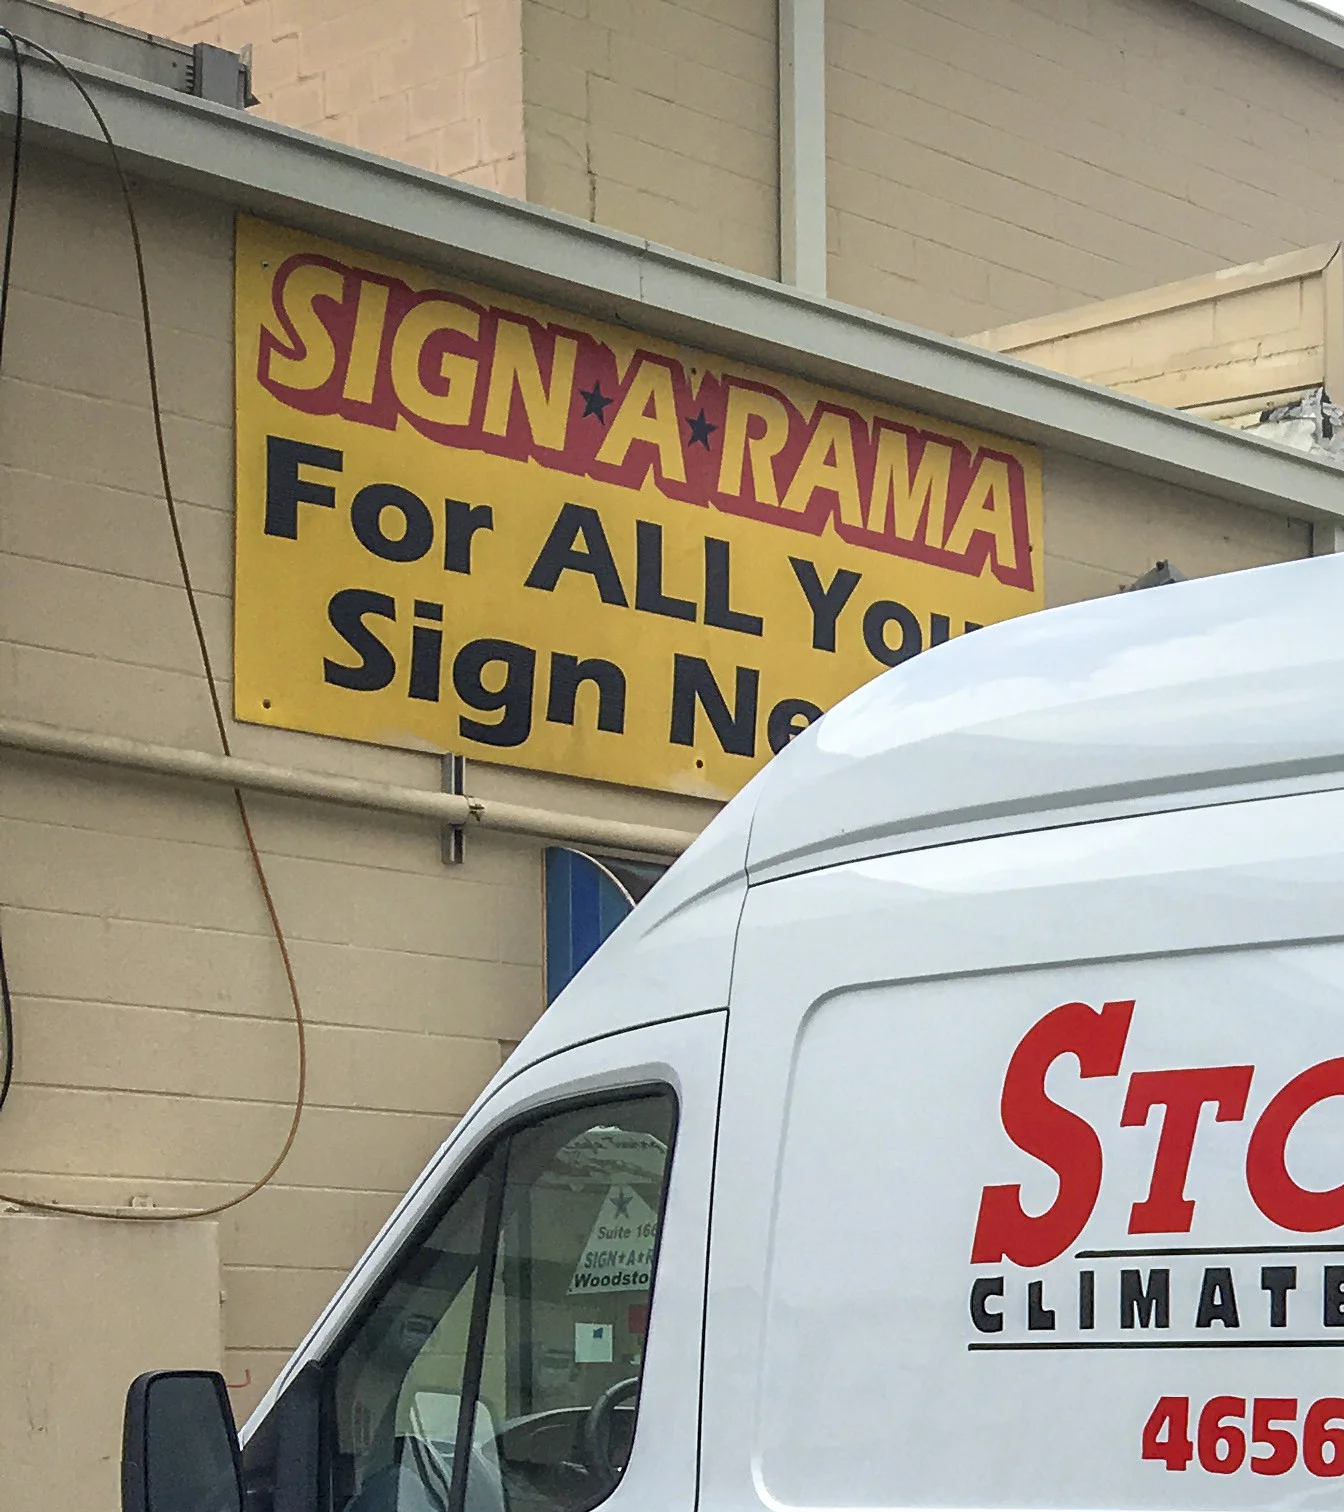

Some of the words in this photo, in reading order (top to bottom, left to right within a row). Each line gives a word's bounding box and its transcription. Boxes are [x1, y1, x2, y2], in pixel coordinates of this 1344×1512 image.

[264, 434, 494, 576] For
[524, 502, 764, 637] ALL
[323, 588, 627, 747] Sign
[597, 1225, 632, 1240] Suite
[574, 1270, 649, 1288] Woodsto
